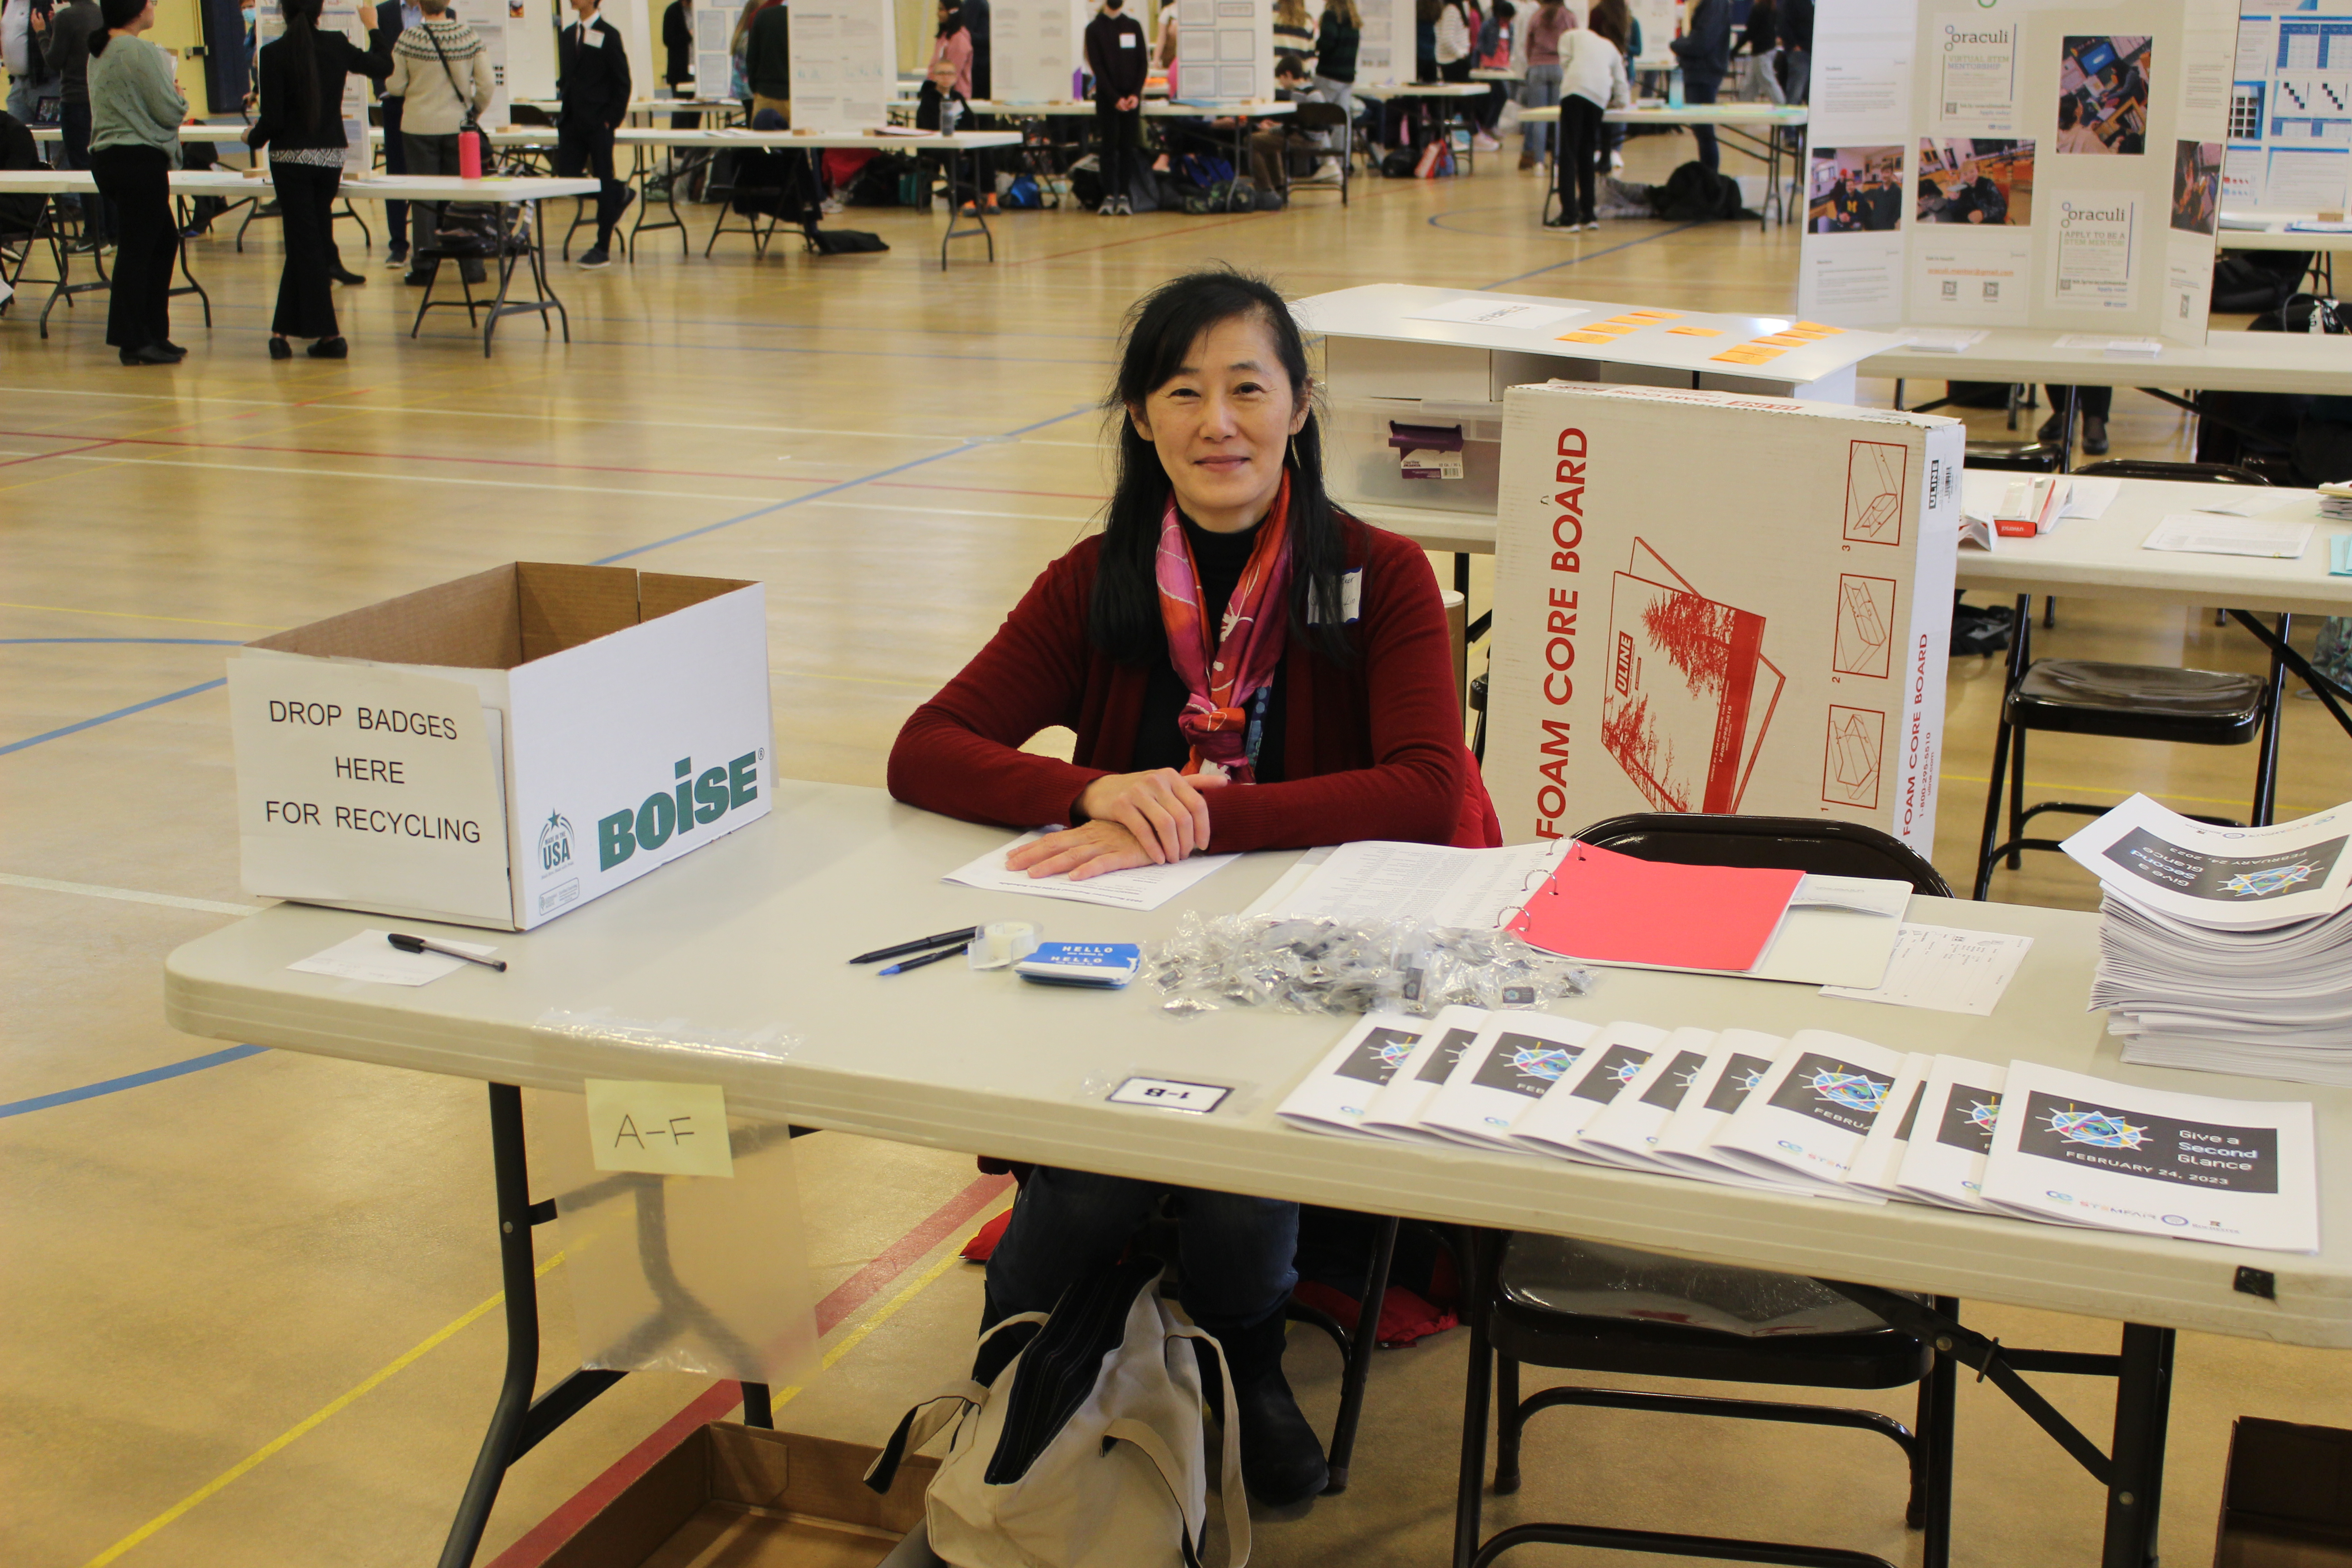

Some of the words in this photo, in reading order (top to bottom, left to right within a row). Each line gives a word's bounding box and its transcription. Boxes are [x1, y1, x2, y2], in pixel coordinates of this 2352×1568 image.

[1951, 29, 2009, 44] oraculi
[2068, 207, 2125, 221] oraculi
[1614, 390, 1662, 398] CORE
[1666, 395, 1721, 404] FOAM
[1738, 401, 1799, 411] ULINE
[1929, 461, 1938, 508] ULINE
[1551, 427, 1588, 573] BOARD
[1543, 588, 1578, 706] CORE
[1617, 635, 1632, 692] ULINE
[1914, 633, 1928, 705] BOARD
[270, 700, 342, 726] DROP
[358, 707, 458, 740] BADGES
[1909, 711, 1921, 770] CORE
[335, 756, 405, 784] HERE
[1535, 720, 1570, 839] FOAM
[1919, 732, 1931, 819] 1-800-295-5510
[1902, 775, 1916, 837] FOAM
[266, 800, 321, 826] FOR
[336, 806, 480, 843] RECYCLING
[543, 837, 571, 870] USA
[544, 835, 554, 845] MADE
[2170, 847, 2203, 861] 2023
[2130, 849, 2197, 880] Second
[2137, 862, 2150, 871] a
[2142, 846, 2204, 873] Glance
[2231, 851, 2308, 866] FEBRUARY
[2151, 870, 2190, 887] Give
[1050, 956, 1103, 964] HELLO
[615, 1114, 695, 1150] A-F
[2179, 1129, 2222, 1143] Give
[2226, 1137, 2240, 1145] a
[2177, 1153, 2254, 1171] Glance
[2178, 1142, 2259, 1159] Second
[2065, 1151, 2154, 1174] FEBRUARY
[2158, 1169, 2183, 1179] 24,
[2189, 1174, 2230, 1185] 2023
